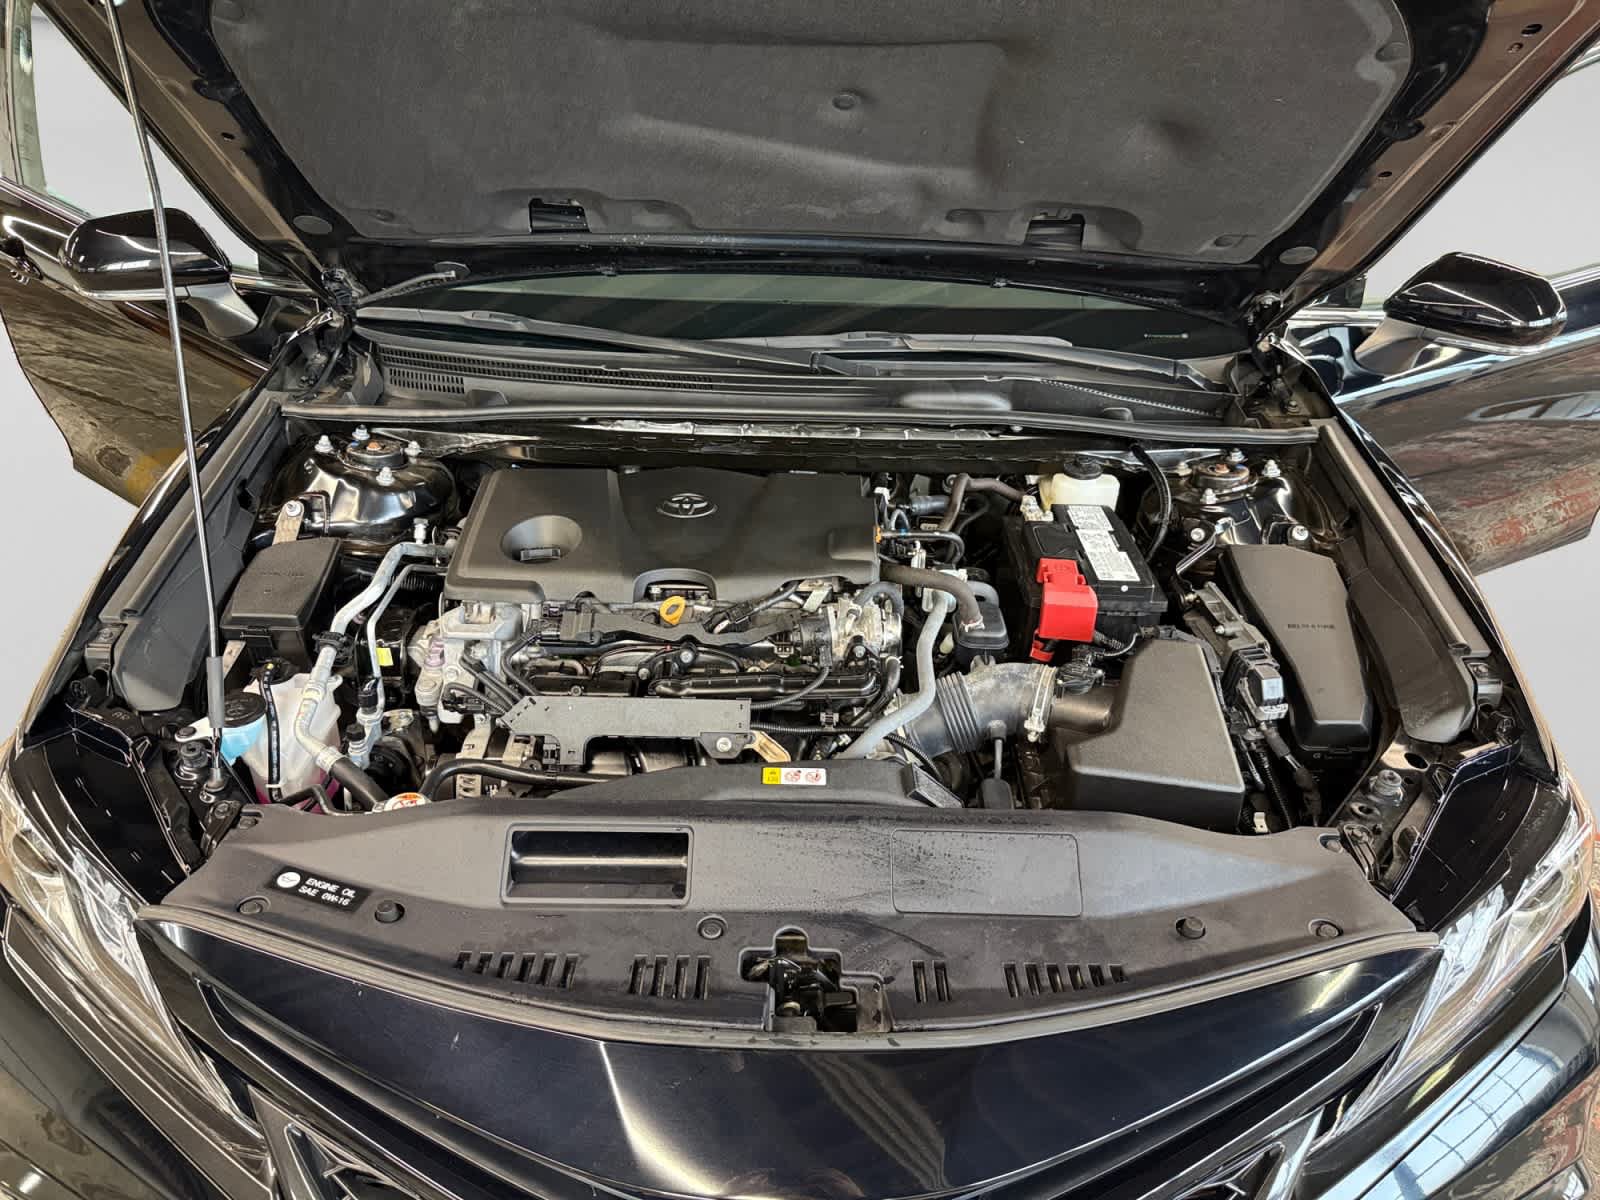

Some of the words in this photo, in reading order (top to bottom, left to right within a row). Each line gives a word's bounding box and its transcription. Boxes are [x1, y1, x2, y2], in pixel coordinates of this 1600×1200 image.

[298, 885, 319, 896] SAE
[321, 892, 350, 906] 0W-16
[305, 877, 340, 892] ENGINE
[341, 888, 356, 898] OIL
